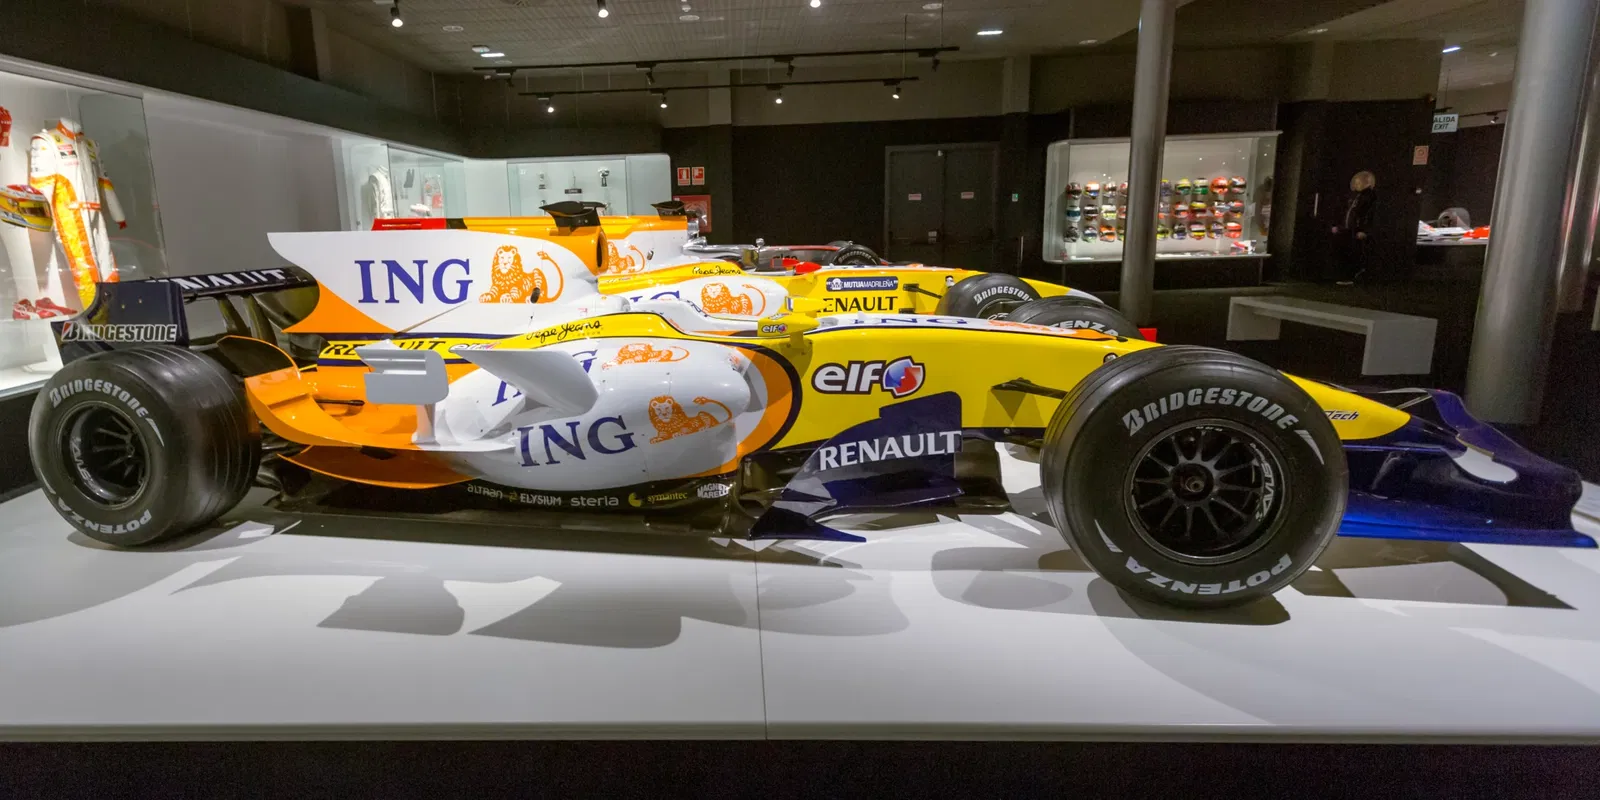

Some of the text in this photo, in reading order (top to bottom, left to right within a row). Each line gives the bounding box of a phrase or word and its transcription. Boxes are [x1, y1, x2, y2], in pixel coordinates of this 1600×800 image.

[354, 258, 473, 304] ING
[817, 296, 898, 313] ENAULT
[61, 322, 177, 342] BRIDGESTONE
[762, 324, 783, 333] elf
[812, 360, 888, 395] elf
[50, 378, 149, 418] BRIDGESTONE
[1122, 387, 1299, 437] BRIDGESTONE
[517, 415, 637, 467] ING
[819, 430, 963, 471] RENAULT
[58, 497, 152, 534] POTENZA
[520, 493, 562, 507] ELYSIUM
[570, 494, 619, 507] steria
[646, 491, 688, 504] symantec
[1125, 553, 1292, 595] POTENZA
